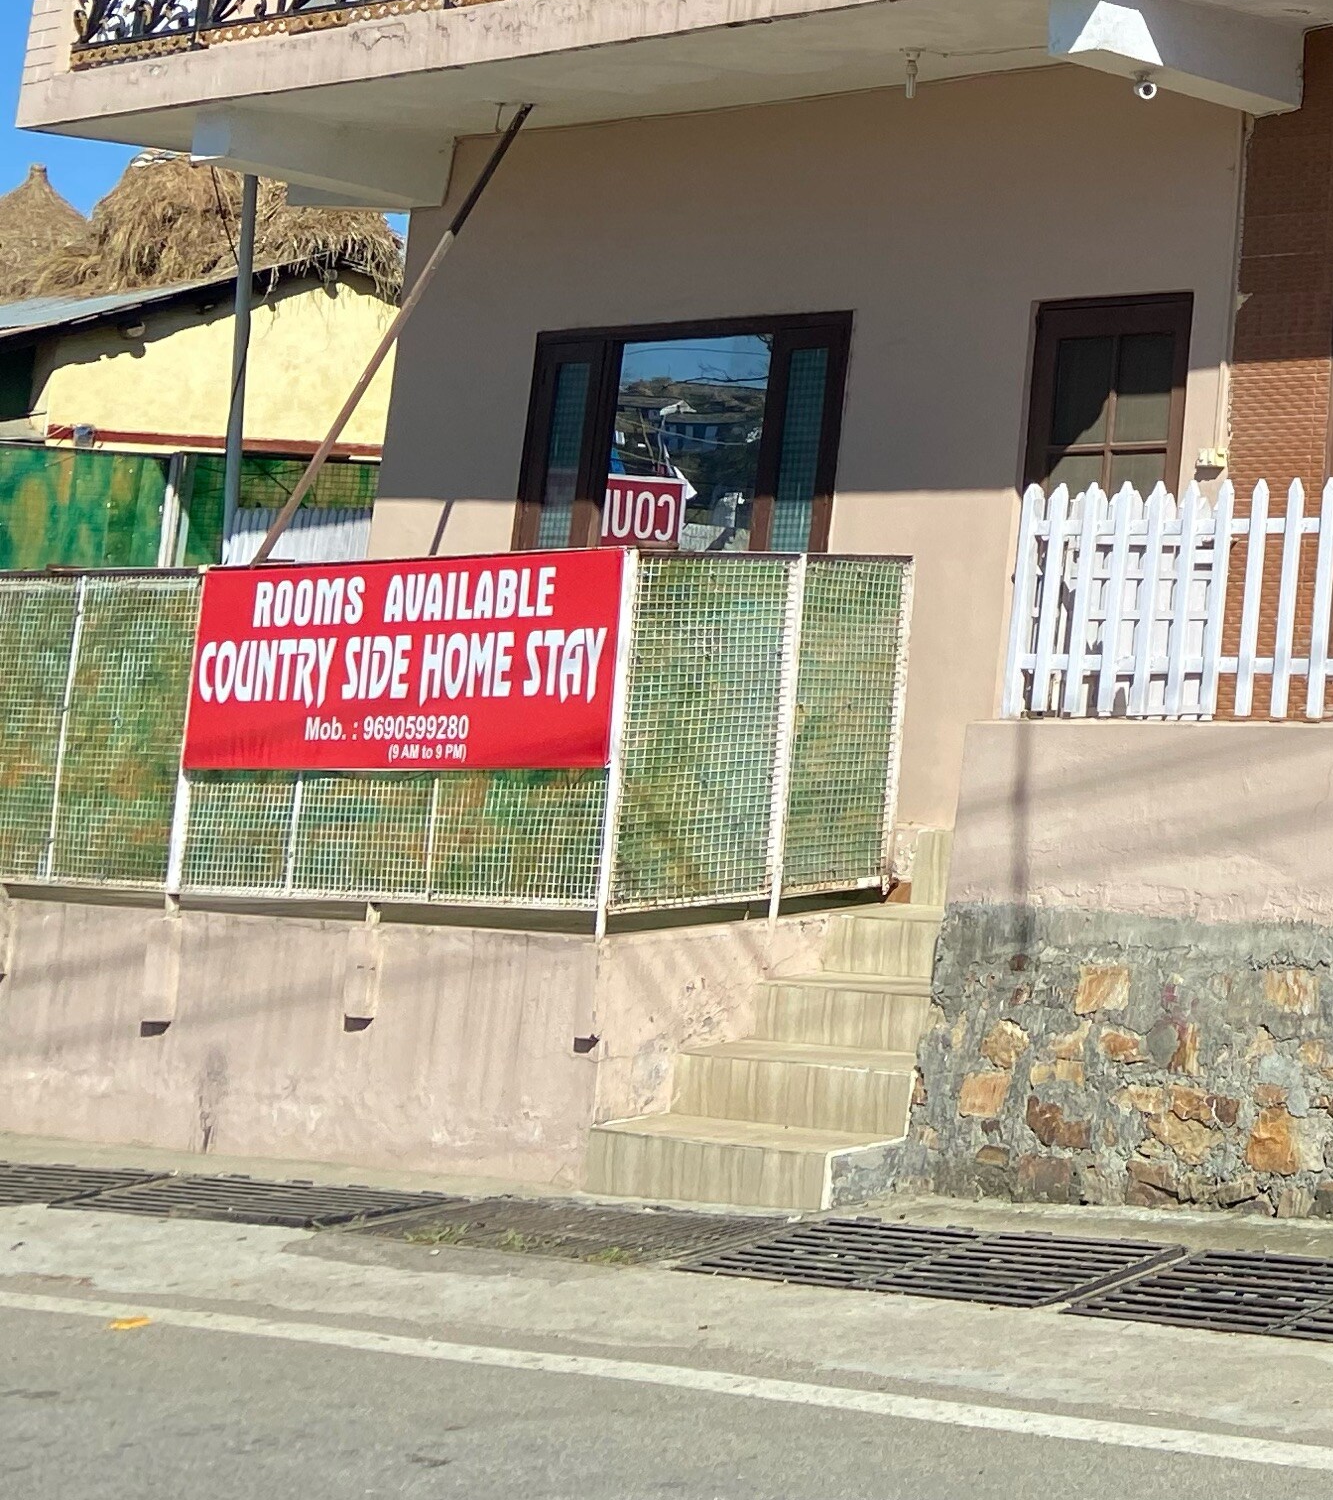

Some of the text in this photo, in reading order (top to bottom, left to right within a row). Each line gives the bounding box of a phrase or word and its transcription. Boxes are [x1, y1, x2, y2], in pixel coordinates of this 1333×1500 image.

[252, 566, 557, 628] ROOMS AVAILABLE
[198, 627, 608, 709] COUNTRY SIDE HOME STAY
[304, 716, 346, 741] Mob.
[363, 714, 470, 741] 9690599280
[388, 743, 467, 763] (9 AM to 9 PM)
